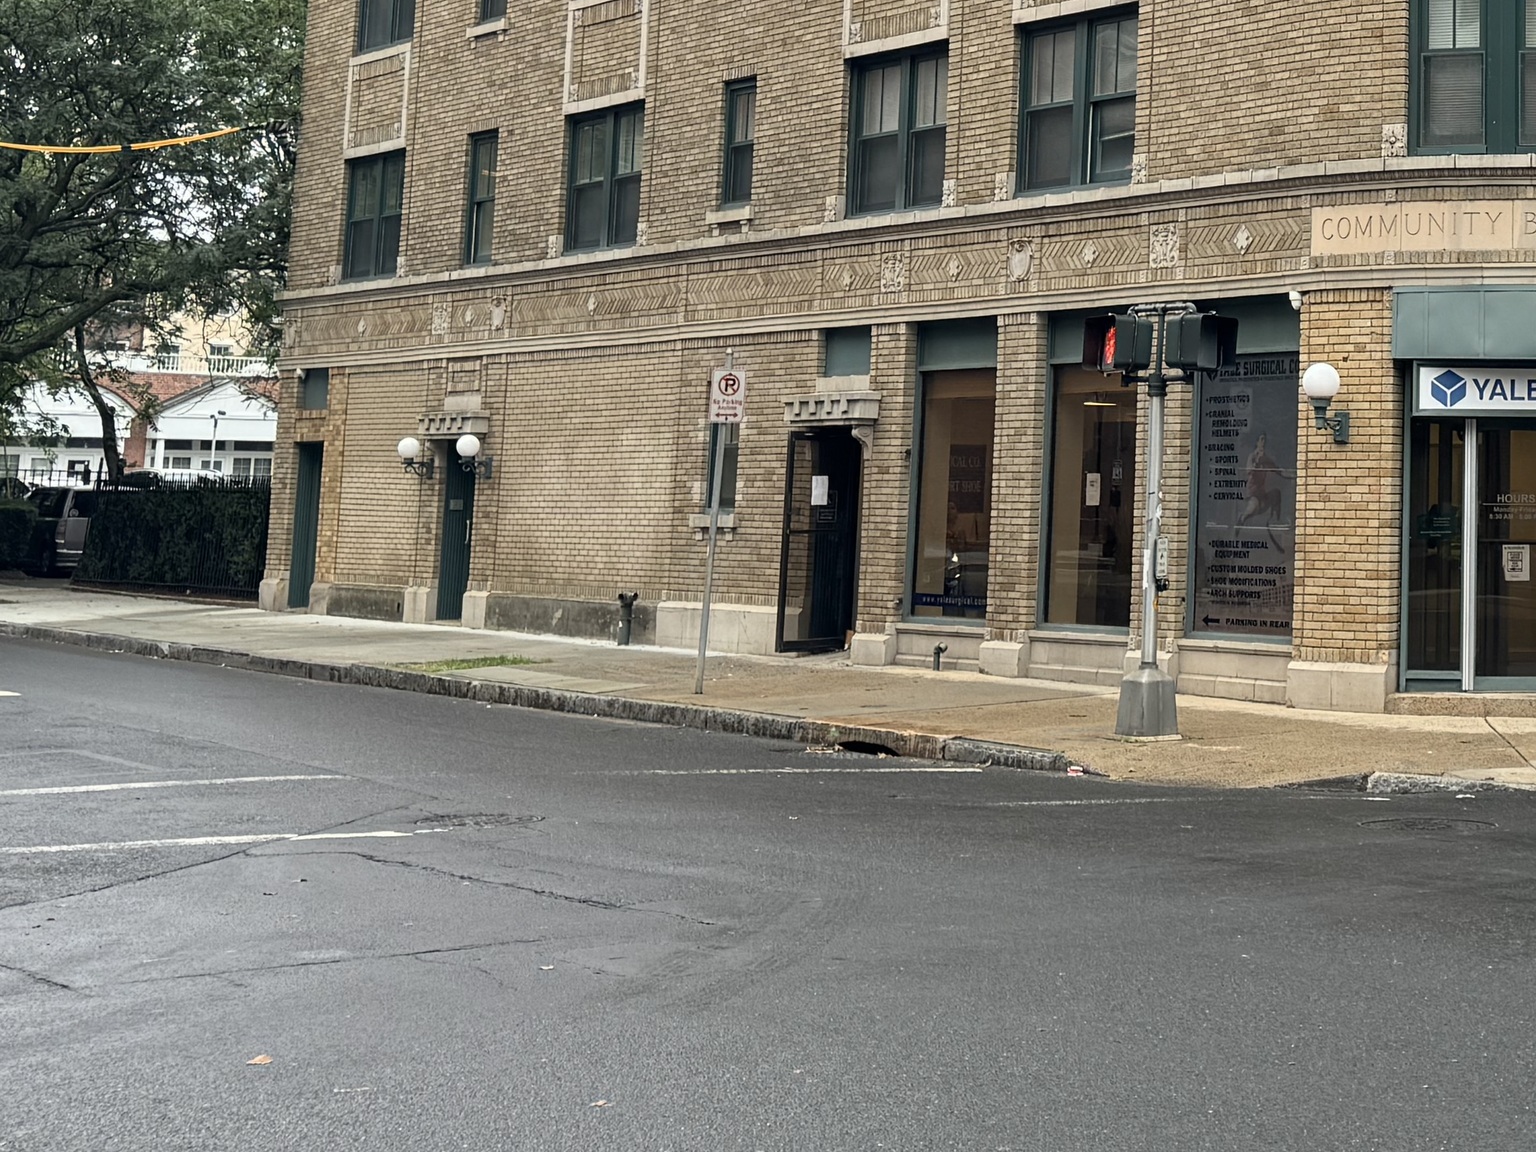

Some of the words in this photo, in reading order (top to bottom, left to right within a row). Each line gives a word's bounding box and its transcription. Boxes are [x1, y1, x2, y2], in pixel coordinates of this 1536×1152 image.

[1321, 211, 1503, 241] COMMUNITY
[1243, 359, 1286, 376] SURGICAL
[1496, 493, 1536, 503] HOURS
[1241, 541, 1268, 549] MEDICAL
[1211, 588, 1227, 597] ARCH
[1226, 618, 1257, 627] PARKING
[1259, 619, 1268, 627] IN
[1270, 619, 1290, 628] REAR
